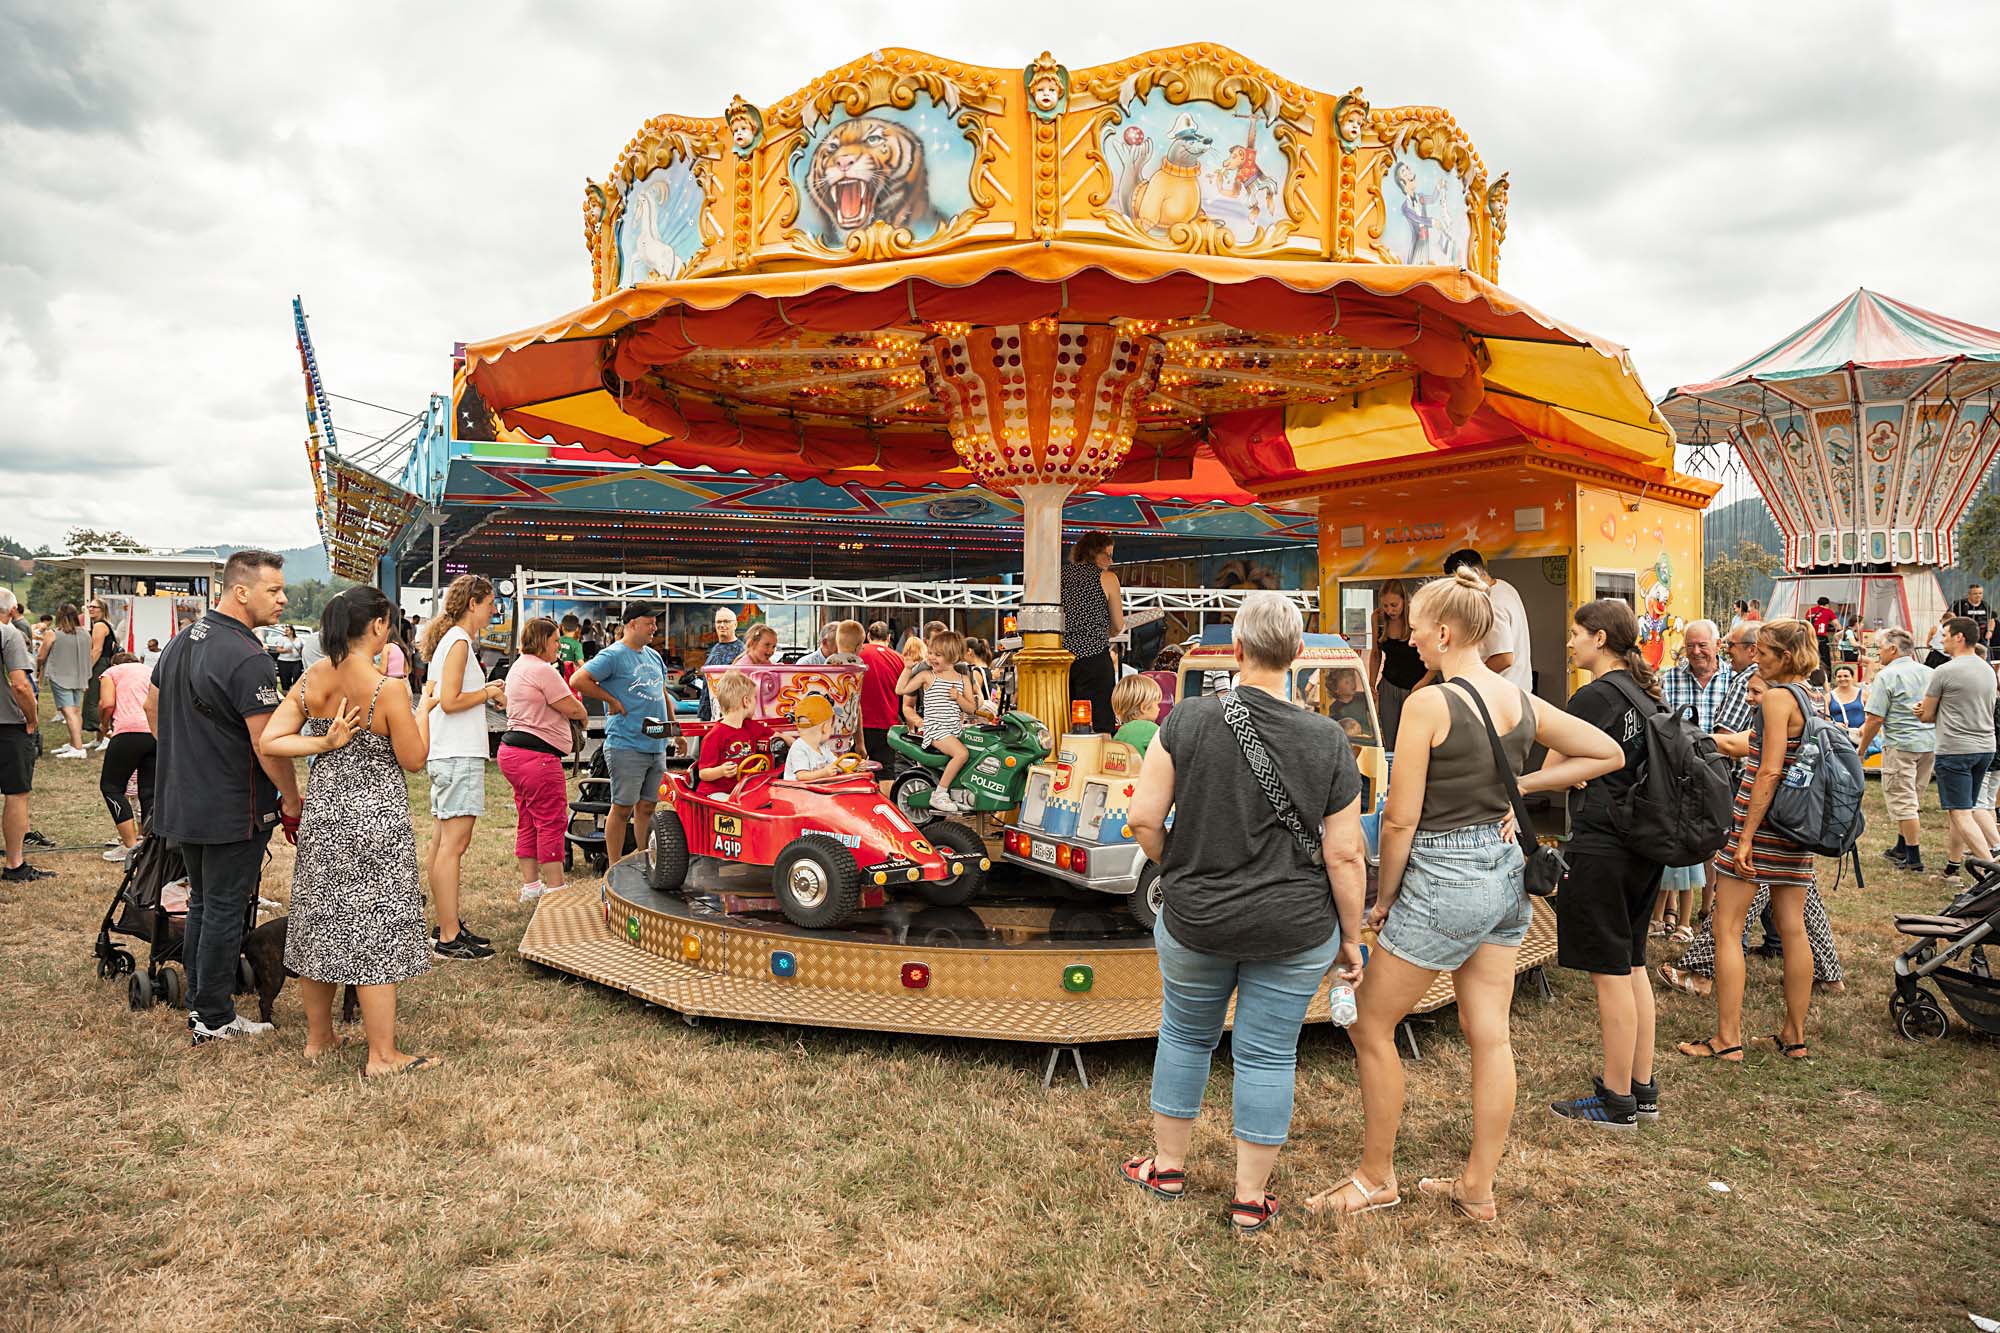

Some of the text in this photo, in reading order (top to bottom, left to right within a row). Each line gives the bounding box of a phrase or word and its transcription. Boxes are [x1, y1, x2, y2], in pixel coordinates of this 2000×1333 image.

[1385, 522, 1446, 544] KASSE
[964, 733, 983, 743] POLIZEI
[970, 774, 1006, 794] POLIZEI
[872, 803, 914, 833] 1
[714, 834, 742, 858] Agip
